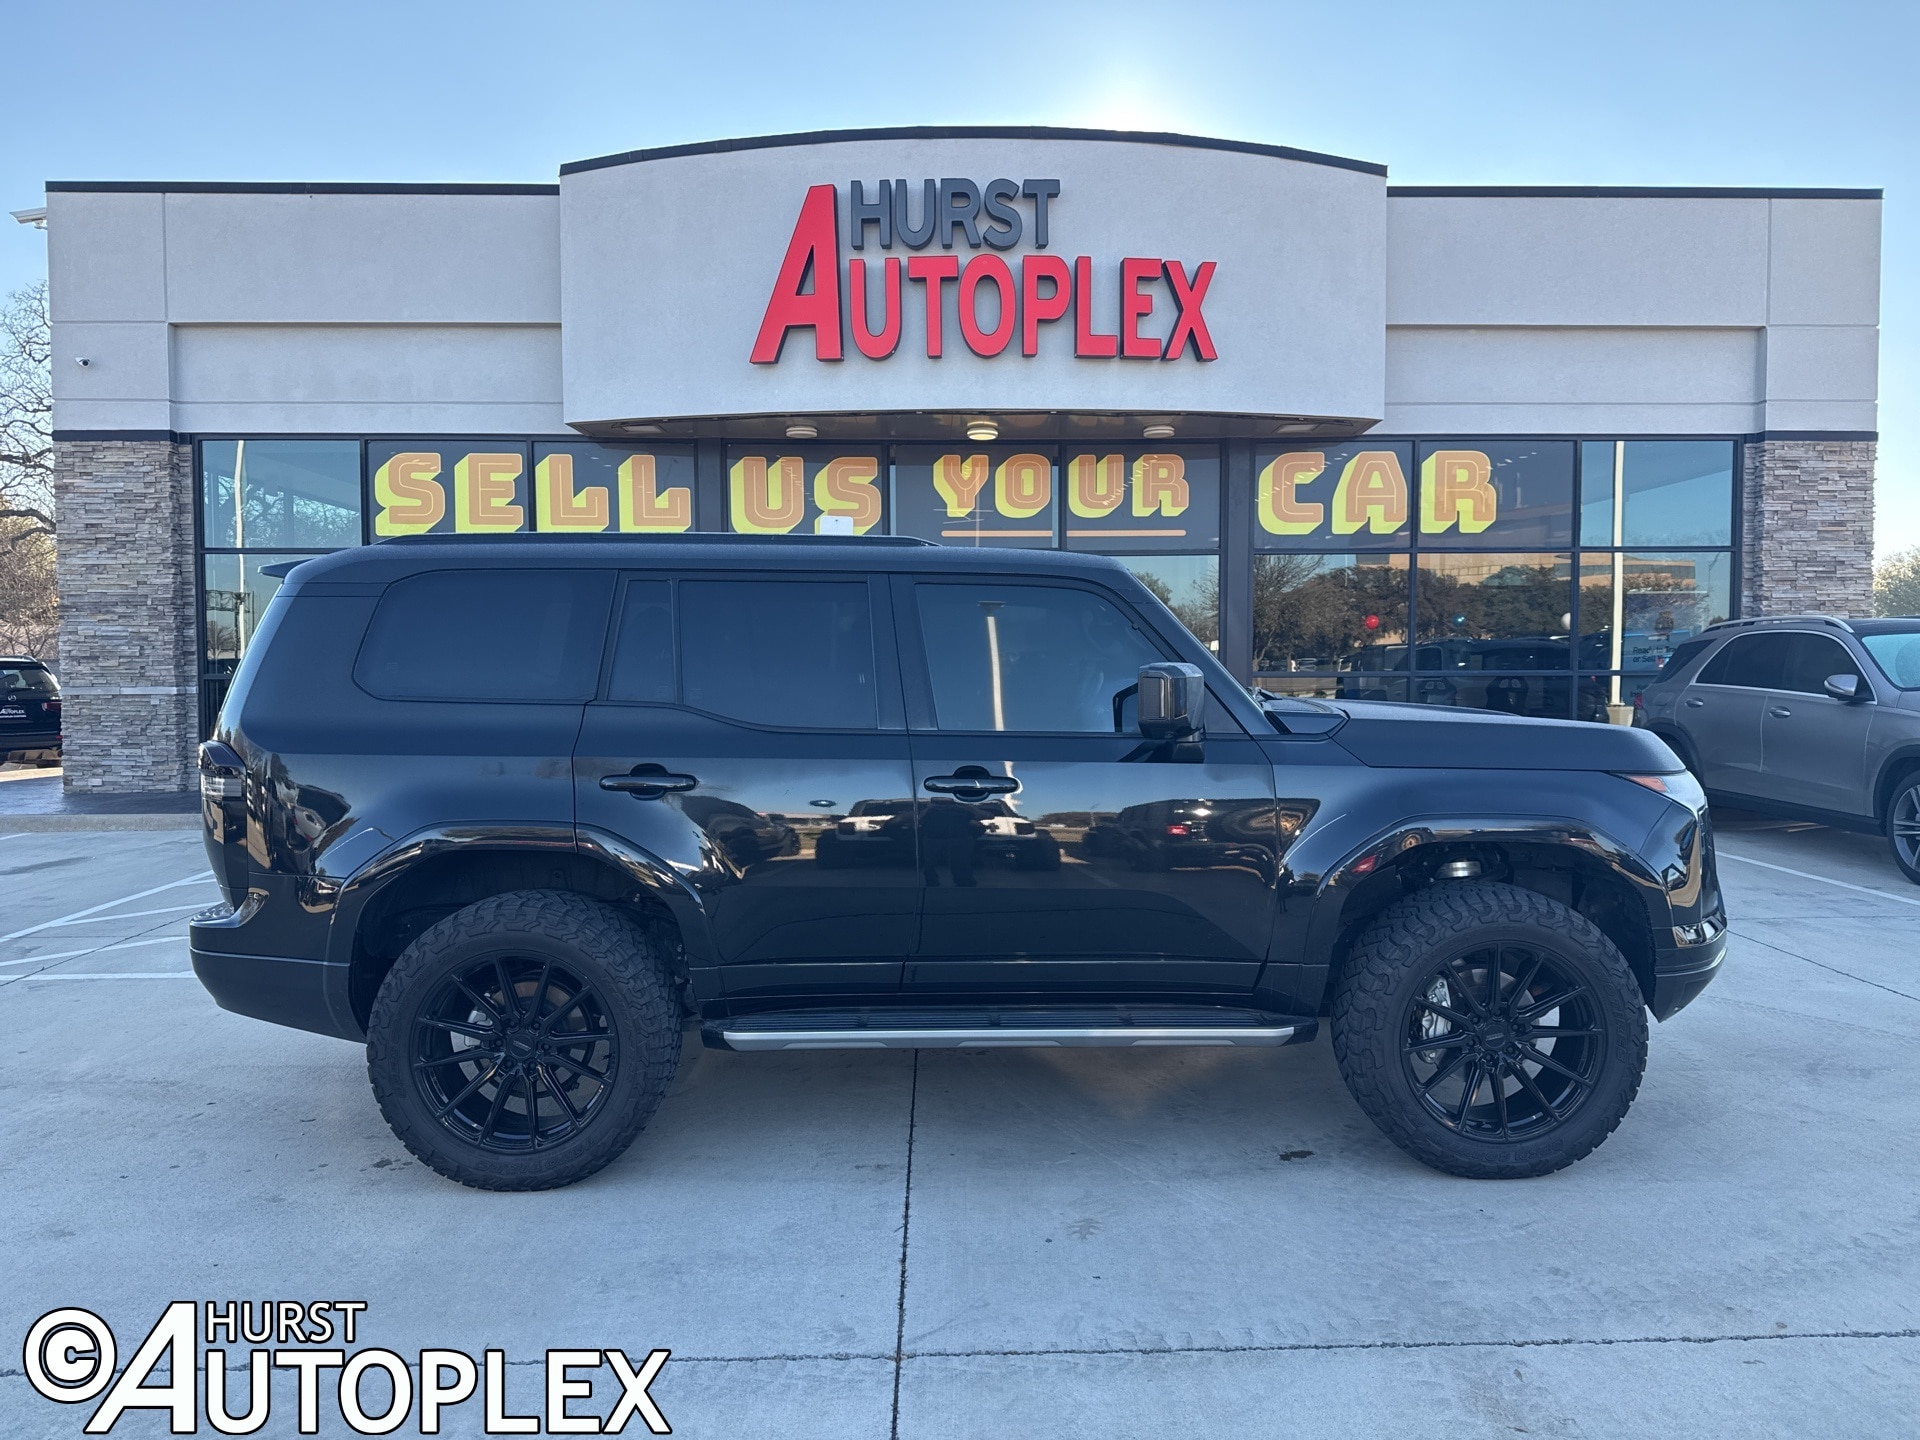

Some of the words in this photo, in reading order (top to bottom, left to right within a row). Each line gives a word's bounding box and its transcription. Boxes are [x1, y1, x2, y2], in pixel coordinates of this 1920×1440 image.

[849, 178, 1061, 250] HURST
[749, 184, 1219, 364] AUTOPLEX
[374, 452, 692, 536] SELL
[730, 455, 882, 536] US
[933, 453, 1190, 519] YOUR
[1258, 450, 1497, 535] CAR
